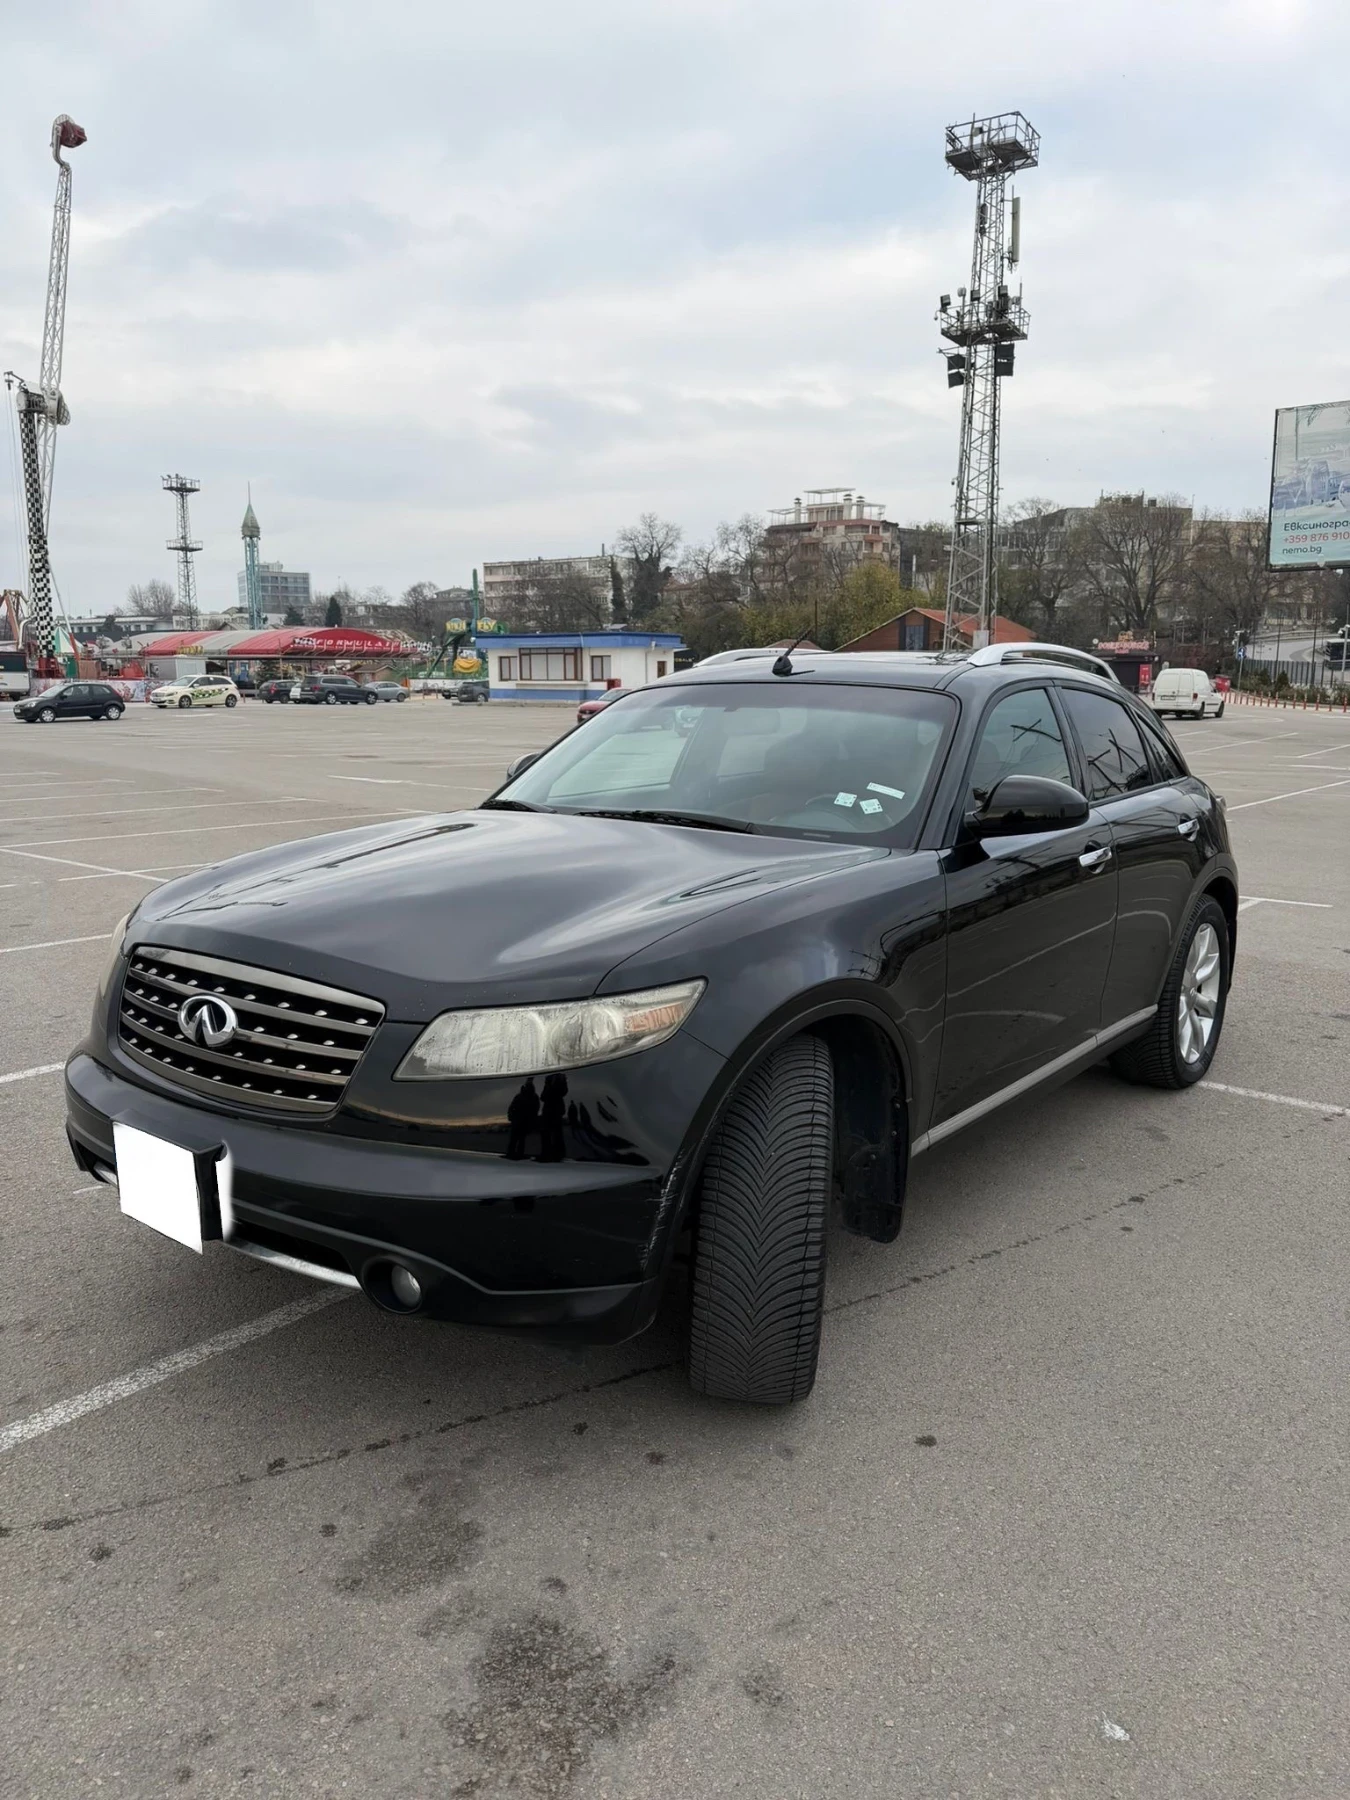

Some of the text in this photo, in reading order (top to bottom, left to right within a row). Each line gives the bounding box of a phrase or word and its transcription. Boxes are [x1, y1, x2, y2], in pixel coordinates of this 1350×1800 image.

[1284, 520, 1350, 531] Евксиногра
[1284, 531, 1350, 543] +359 876 910
[1282, 545, 1322, 554] nemo.bg
